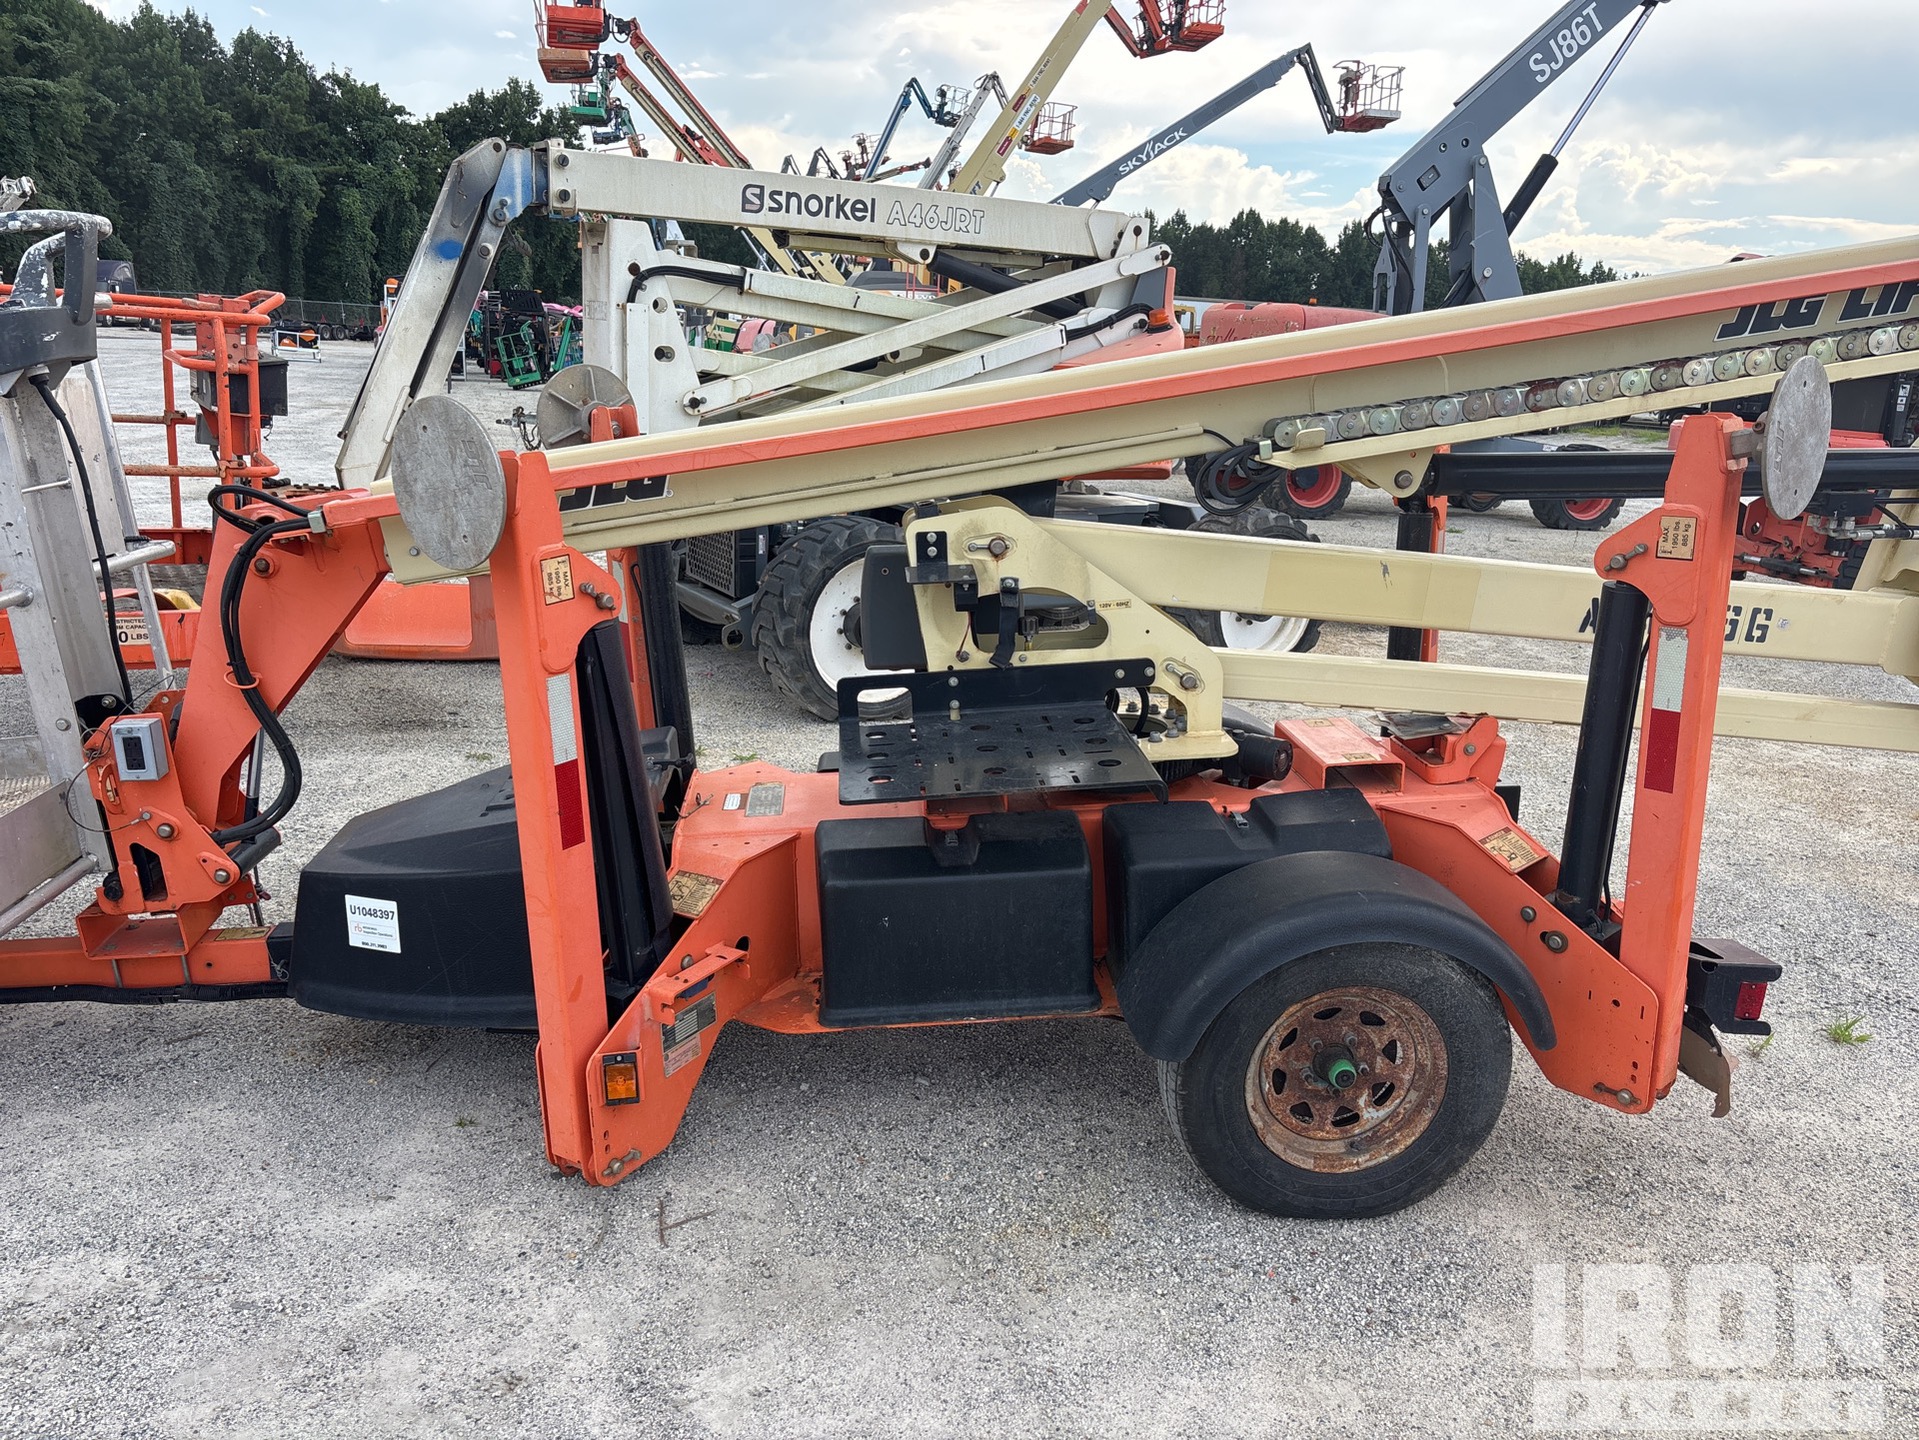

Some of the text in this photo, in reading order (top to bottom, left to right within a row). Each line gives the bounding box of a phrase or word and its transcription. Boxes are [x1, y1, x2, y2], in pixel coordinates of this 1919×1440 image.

[1529, 1, 1603, 83] SJ86T
[1118, 127, 1187, 175] SKYJACK
[768, 189, 876, 223] snorkel
[886, 200, 985, 234] A46JRT
[1714, 292, 1828, 342] JLG
[349, 904, 395, 921] U1048397
